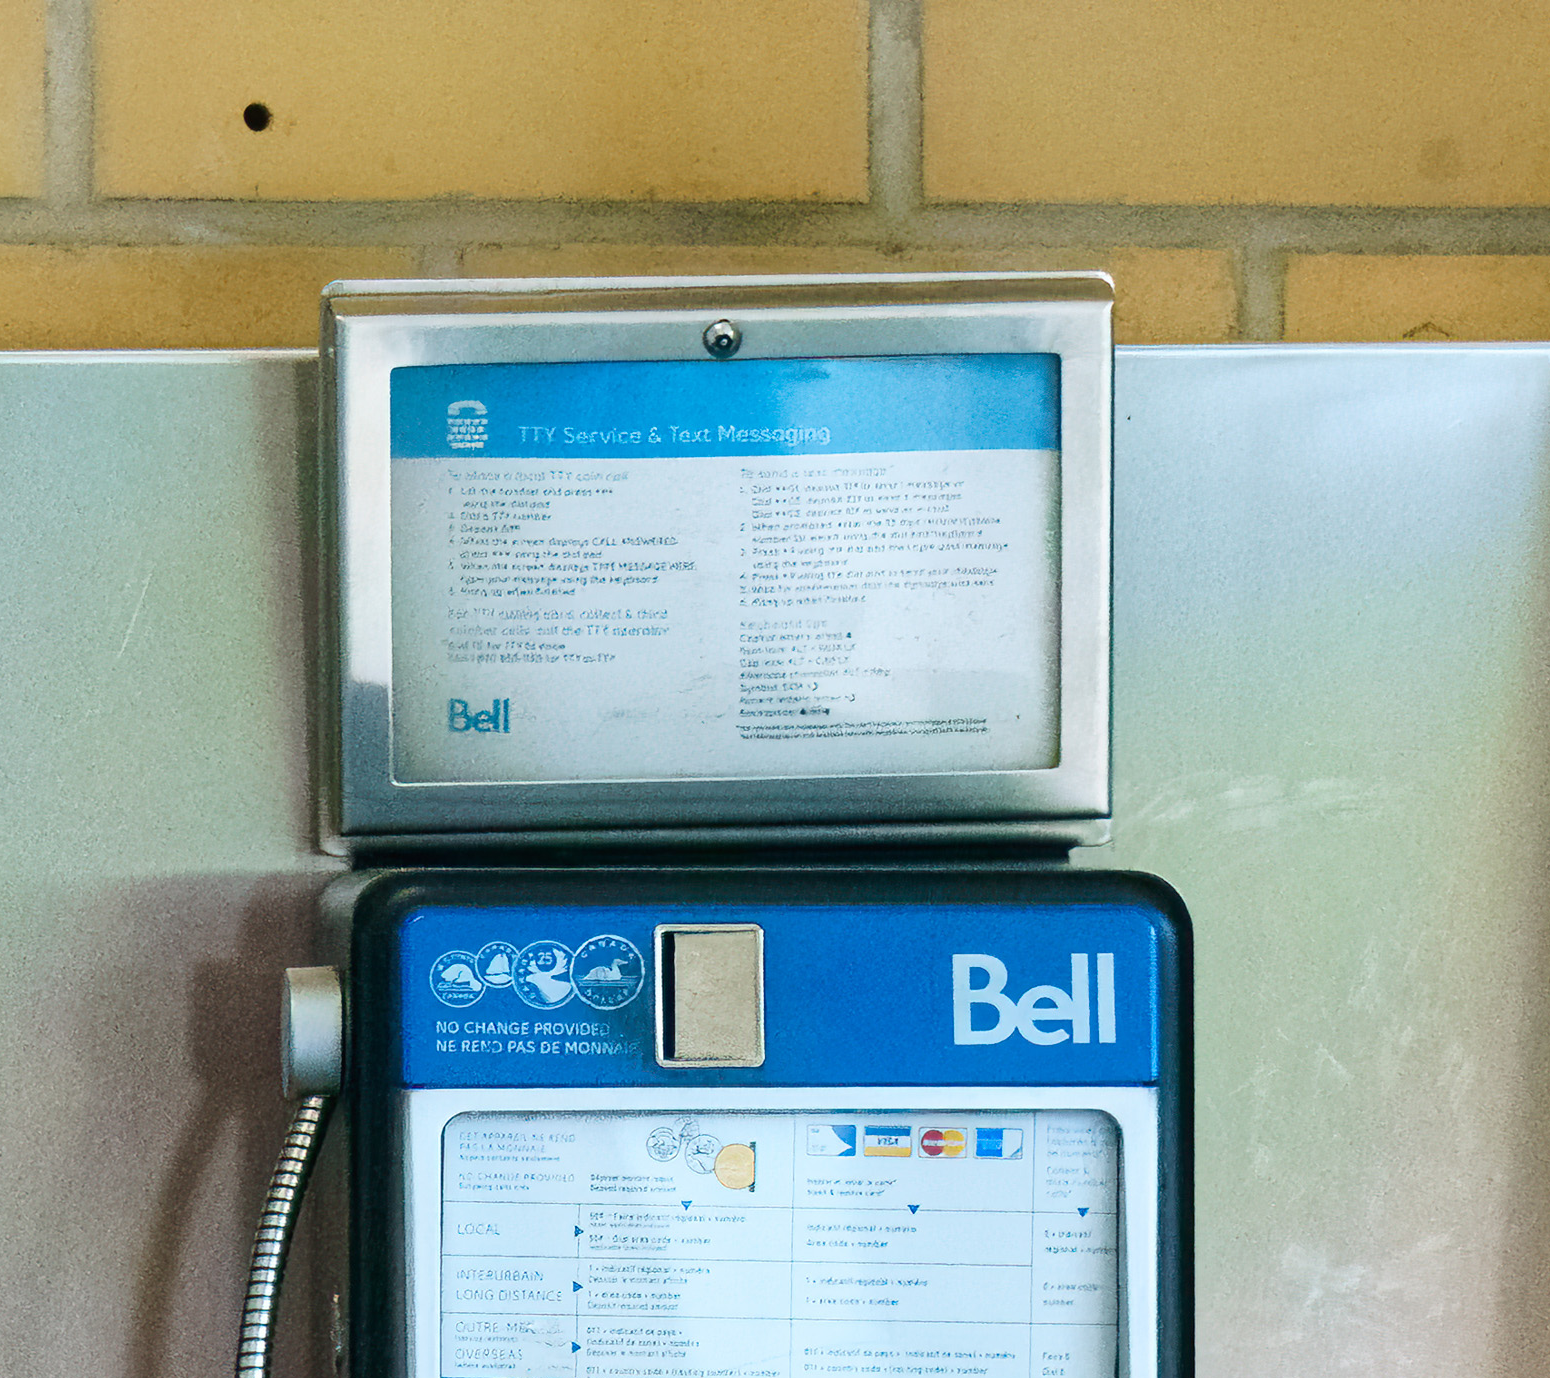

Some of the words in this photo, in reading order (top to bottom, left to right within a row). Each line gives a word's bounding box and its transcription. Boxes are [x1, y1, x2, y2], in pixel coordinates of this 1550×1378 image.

[518, 426, 556, 443] TTY
[564, 426, 642, 445] Service
[648, 426, 662, 443] &
[669, 425, 711, 443] Text
[717, 424, 832, 445] Messaging
[449, 697, 511, 734] Bell
[951, 952, 1118, 1048] Bell
[436, 1021, 460, 1034] NO
[464, 1021, 530, 1035] CHANGE
[534, 1022, 611, 1036] PROVIDED
[436, 1039, 457, 1052] NE
[507, 1041, 536, 1053] PAS
[540, 1041, 561, 1054] DE
[457, 1223, 500, 1236] LOCAL
[456, 1270, 544, 1282] INTERURBAIN
[456, 1289, 494, 1301] LONG
[498, 1290, 563, 1302] DISTANCE
[455, 1348, 524, 1361] OVERSEAS
